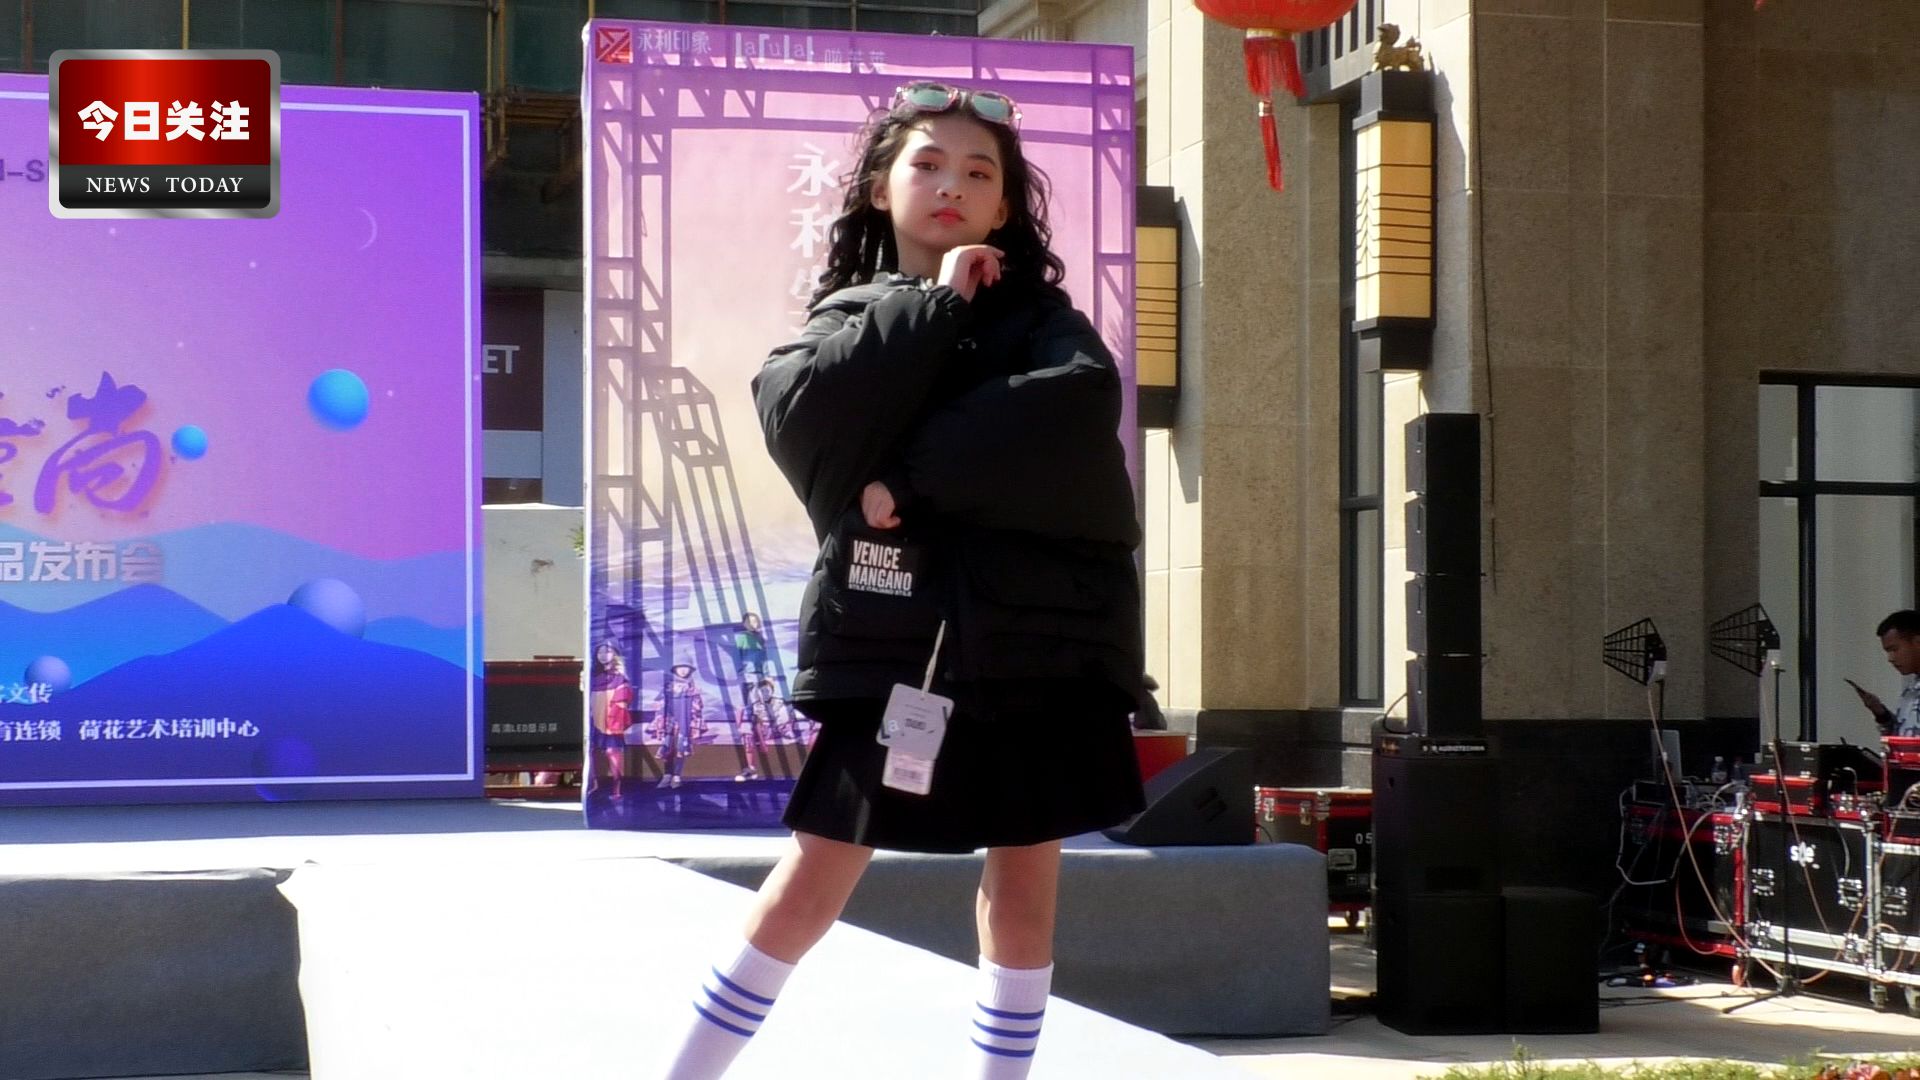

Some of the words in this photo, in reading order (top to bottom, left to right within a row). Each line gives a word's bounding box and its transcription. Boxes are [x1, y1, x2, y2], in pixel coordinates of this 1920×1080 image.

[637, 27, 711, 54] 永利印象
[0, 541, 163, 582] 品发布会
[853, 540, 902, 570] VENICE
[849, 564, 913, 591] MANGANO
[0, 682, 53, 704] 文传
[79, 718, 260, 740] 荷花艺术培训中心
